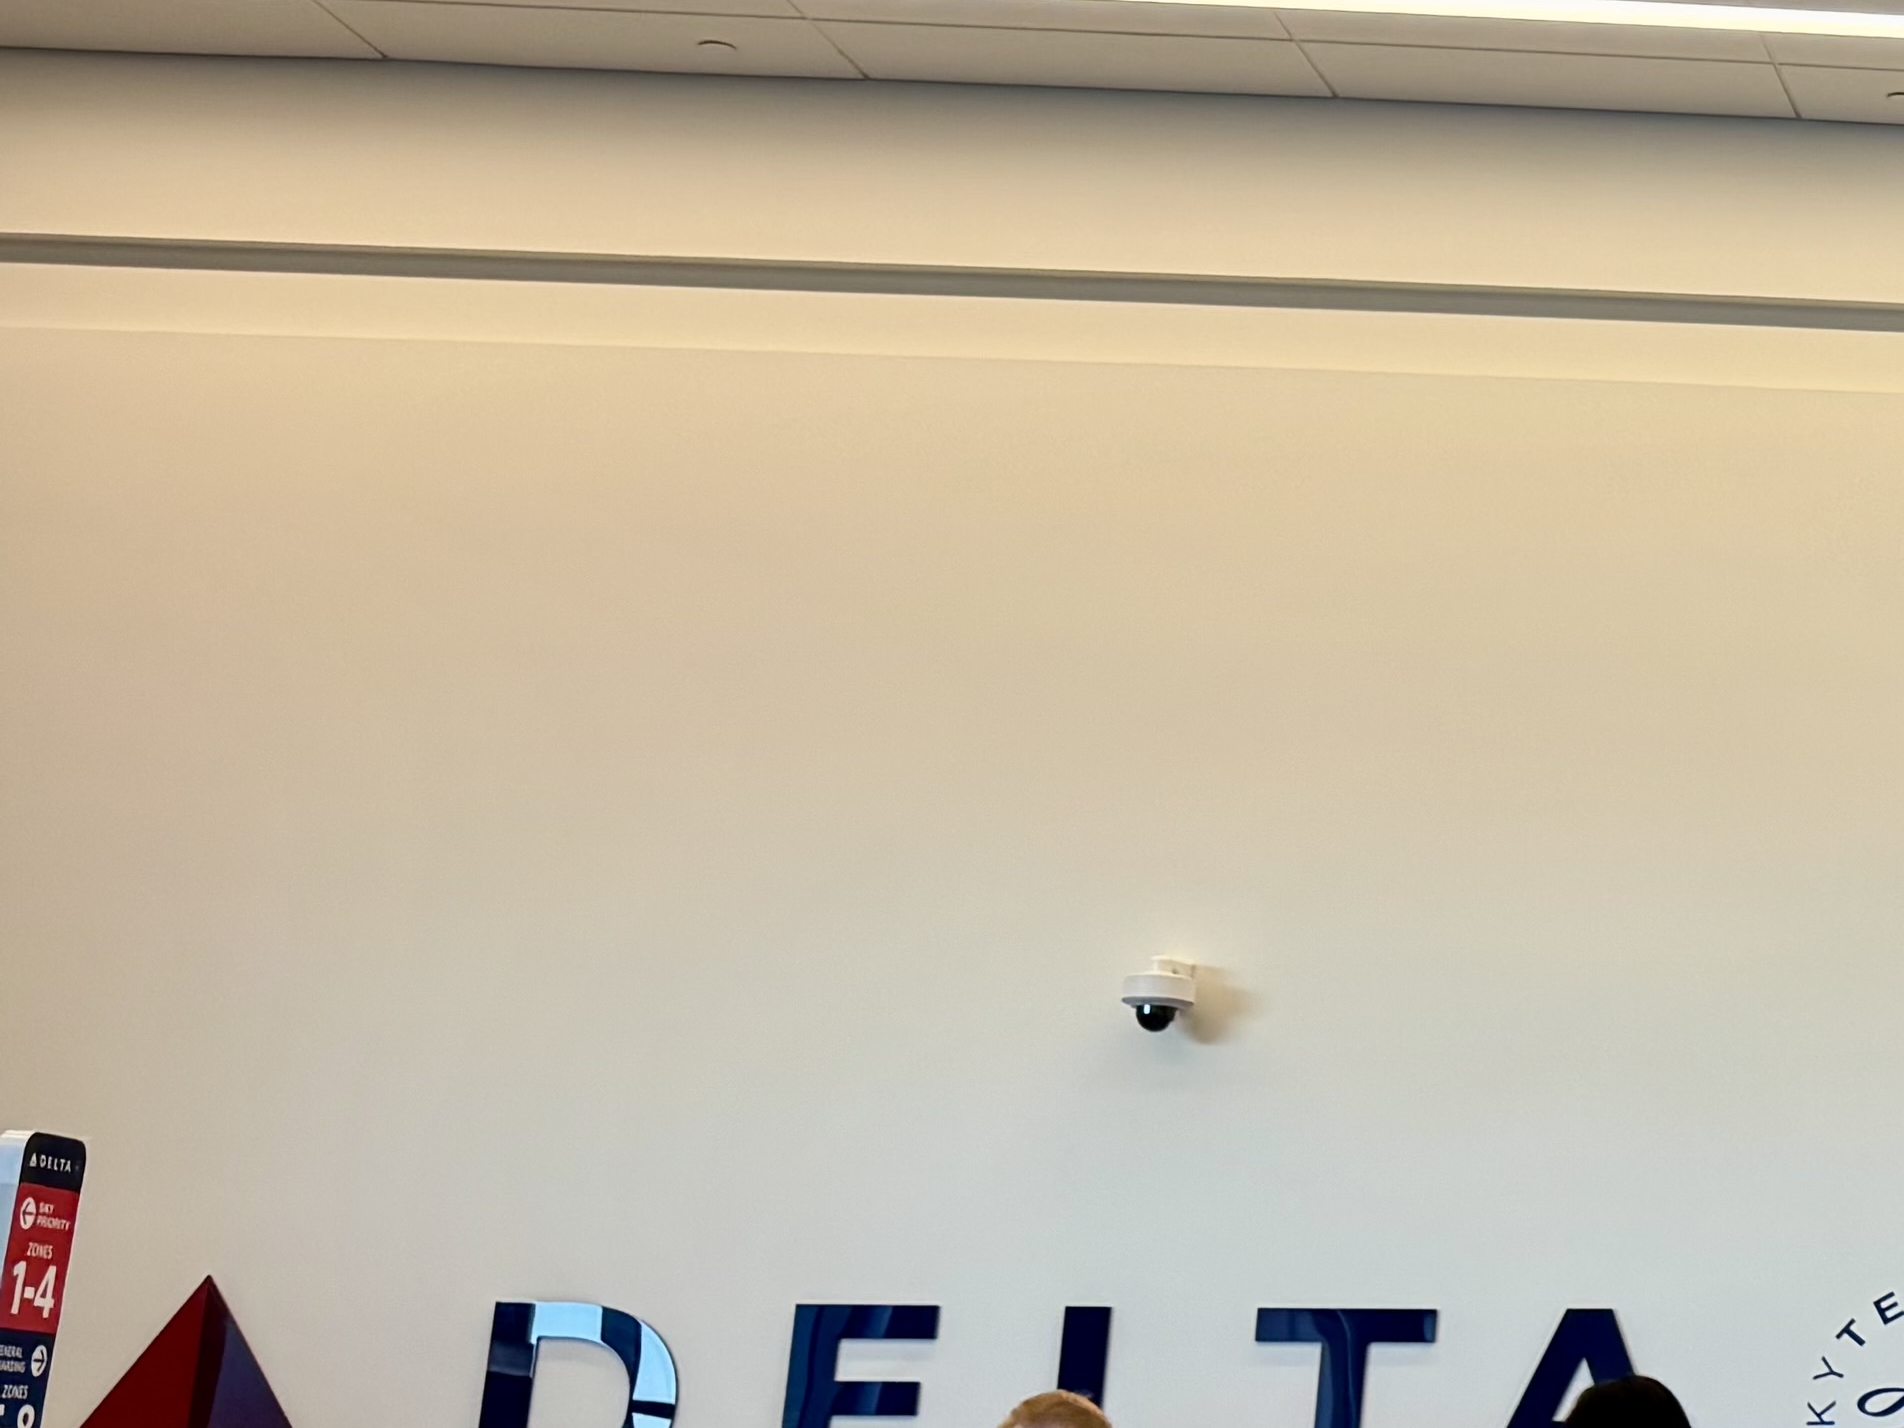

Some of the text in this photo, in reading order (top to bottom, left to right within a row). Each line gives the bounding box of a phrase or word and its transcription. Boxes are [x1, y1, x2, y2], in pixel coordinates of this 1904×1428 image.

[39, 1154, 72, 1173] DELTA
[26, 1241, 54, 1260] ZONES
[10, 1260, 57, 1319] 1-4
[2, 1384, 29, 1400] ZONES
